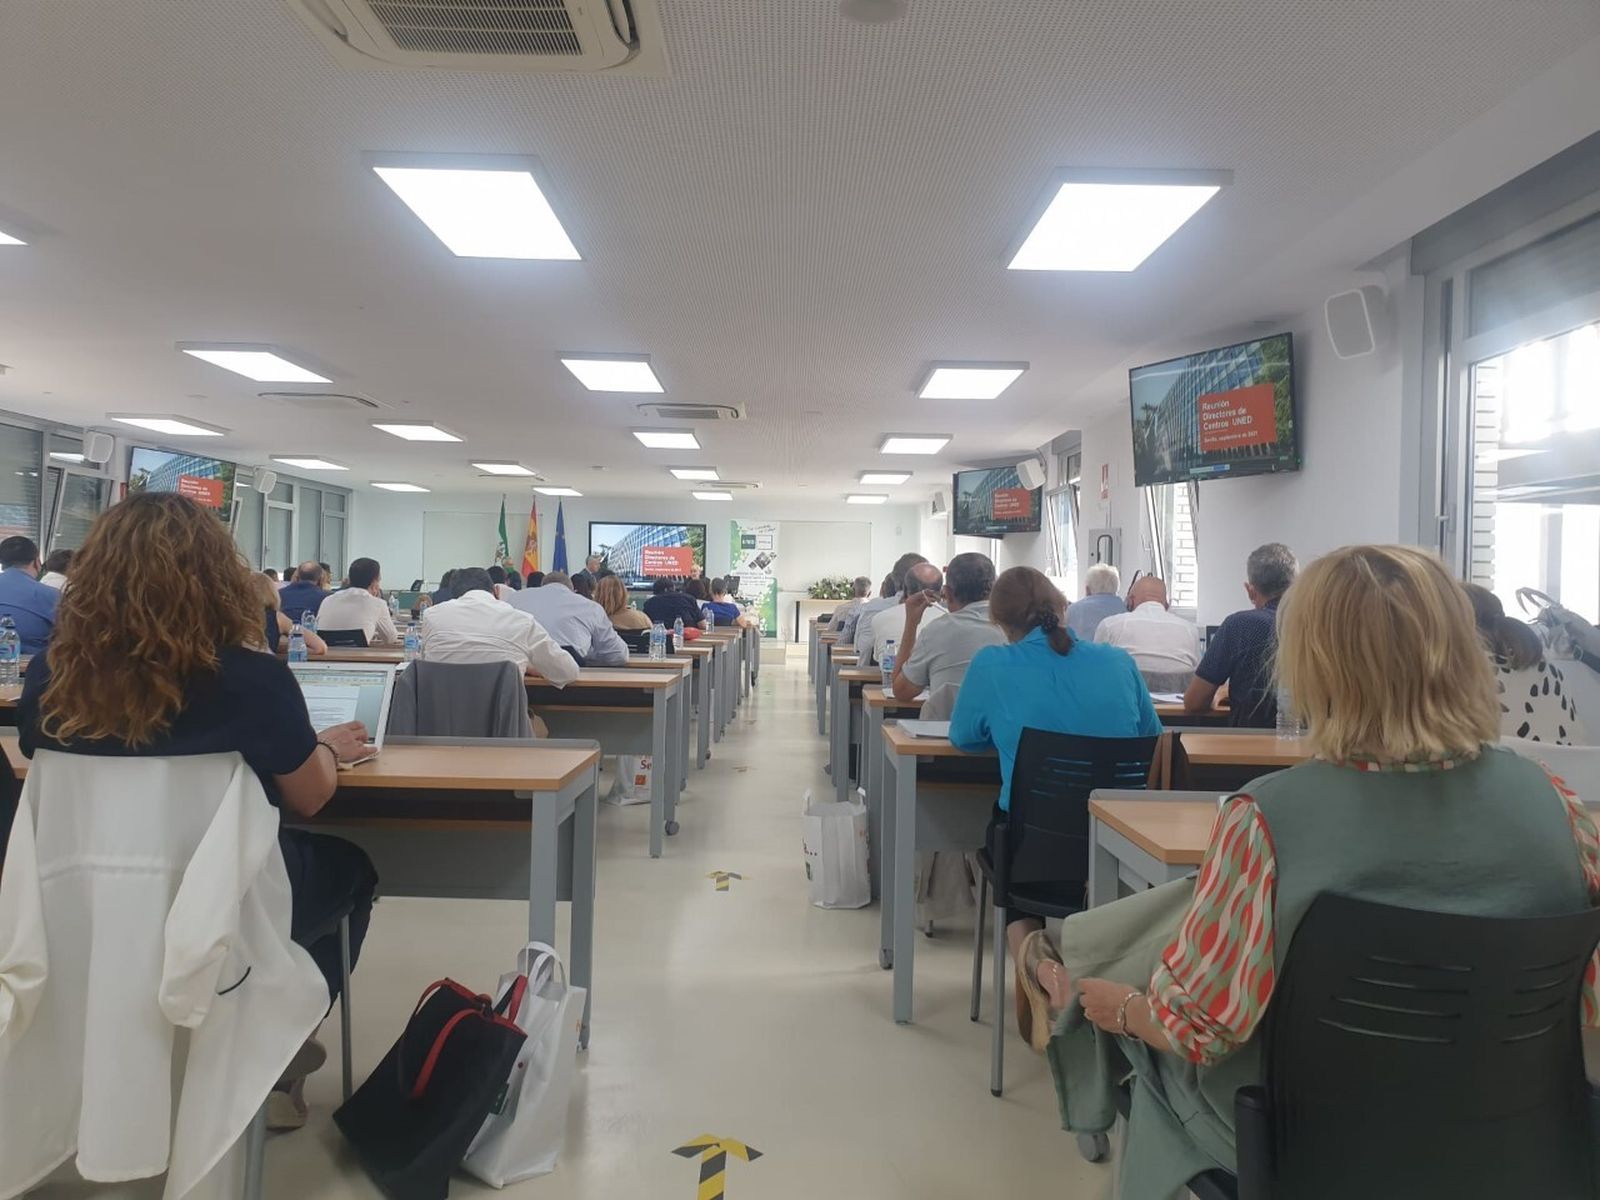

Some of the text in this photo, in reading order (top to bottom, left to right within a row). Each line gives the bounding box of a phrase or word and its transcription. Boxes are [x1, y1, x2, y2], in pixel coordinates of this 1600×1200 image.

[1203, 409, 1236, 421] Directores
[1203, 415, 1252, 431] Centros UNED
